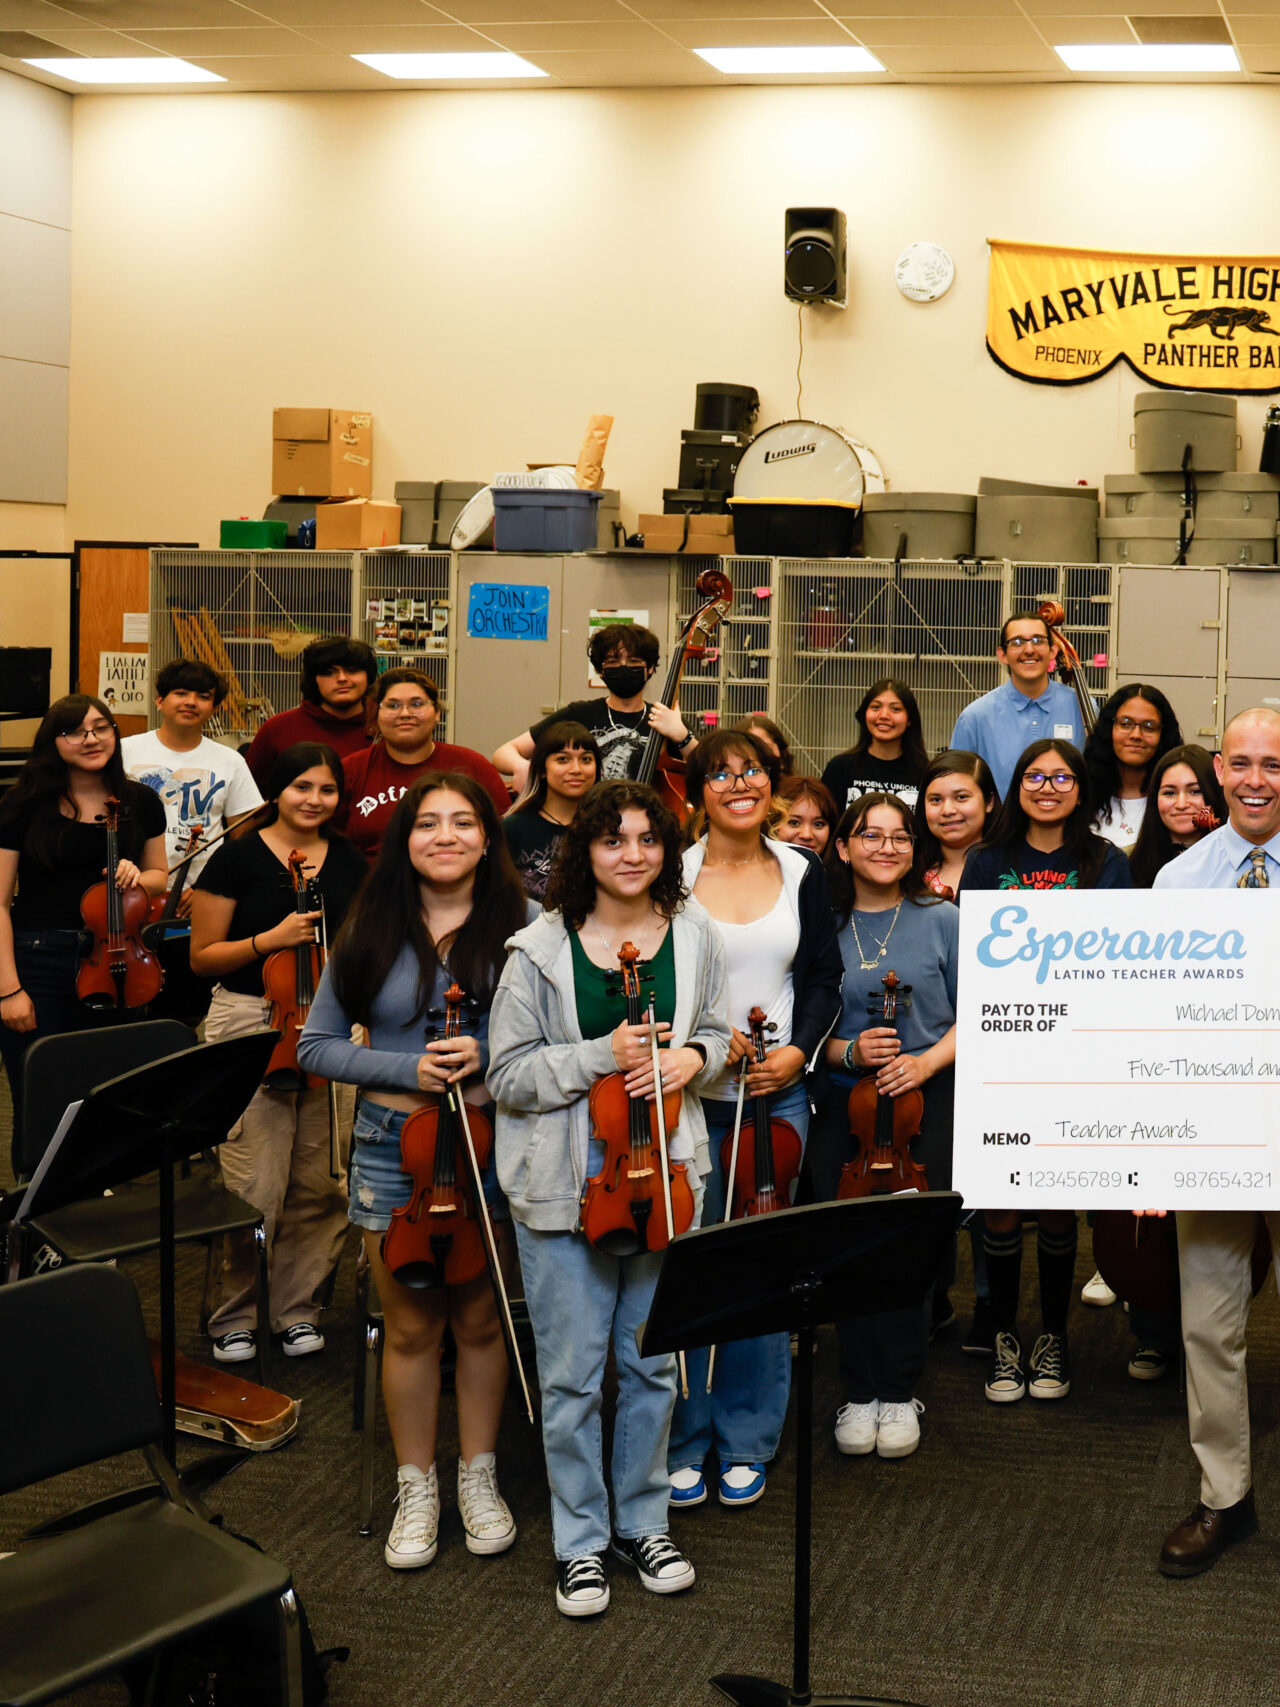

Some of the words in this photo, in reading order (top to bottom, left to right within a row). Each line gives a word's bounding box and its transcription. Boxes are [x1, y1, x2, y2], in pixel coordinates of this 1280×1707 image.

[1008, 266, 1200, 340] MARYVALE
[1035, 345, 1102, 366] PHOENIX
[1143, 343, 1239, 368] PANTHER
[483, 588, 525, 608] JOIN
[472, 608, 547, 635] ORCHESTRA
[890, 783, 917, 791] UNION
[1022, 870, 1067, 884] LIVING
[977, 905, 1247, 984] Esperanza
[1054, 969, 1105, 980] LATINO
[1112, 969, 1176, 979] TEACHER
[1183, 968, 1244, 979] AWARDS
[981, 1004, 1011, 1016] PAY
[1013, 1004, 1035, 1016] TO
[1038, 1004, 1068, 1016] THE
[1176, 1004, 1238, 1022] Michael
[981, 1019, 1033, 1032] ORDER
[1036, 1019, 1057, 1032] OF
[1127, 1057, 1254, 1079] Five-Thousand
[983, 1132, 1031, 1145] MEMO
[1055, 1120, 1126, 1139] Teacher
[1131, 1119, 1198, 1141] Awards
[1026, 1171, 1122, 1188] 123456789
[1173, 1171, 1272, 1189] 987654321
